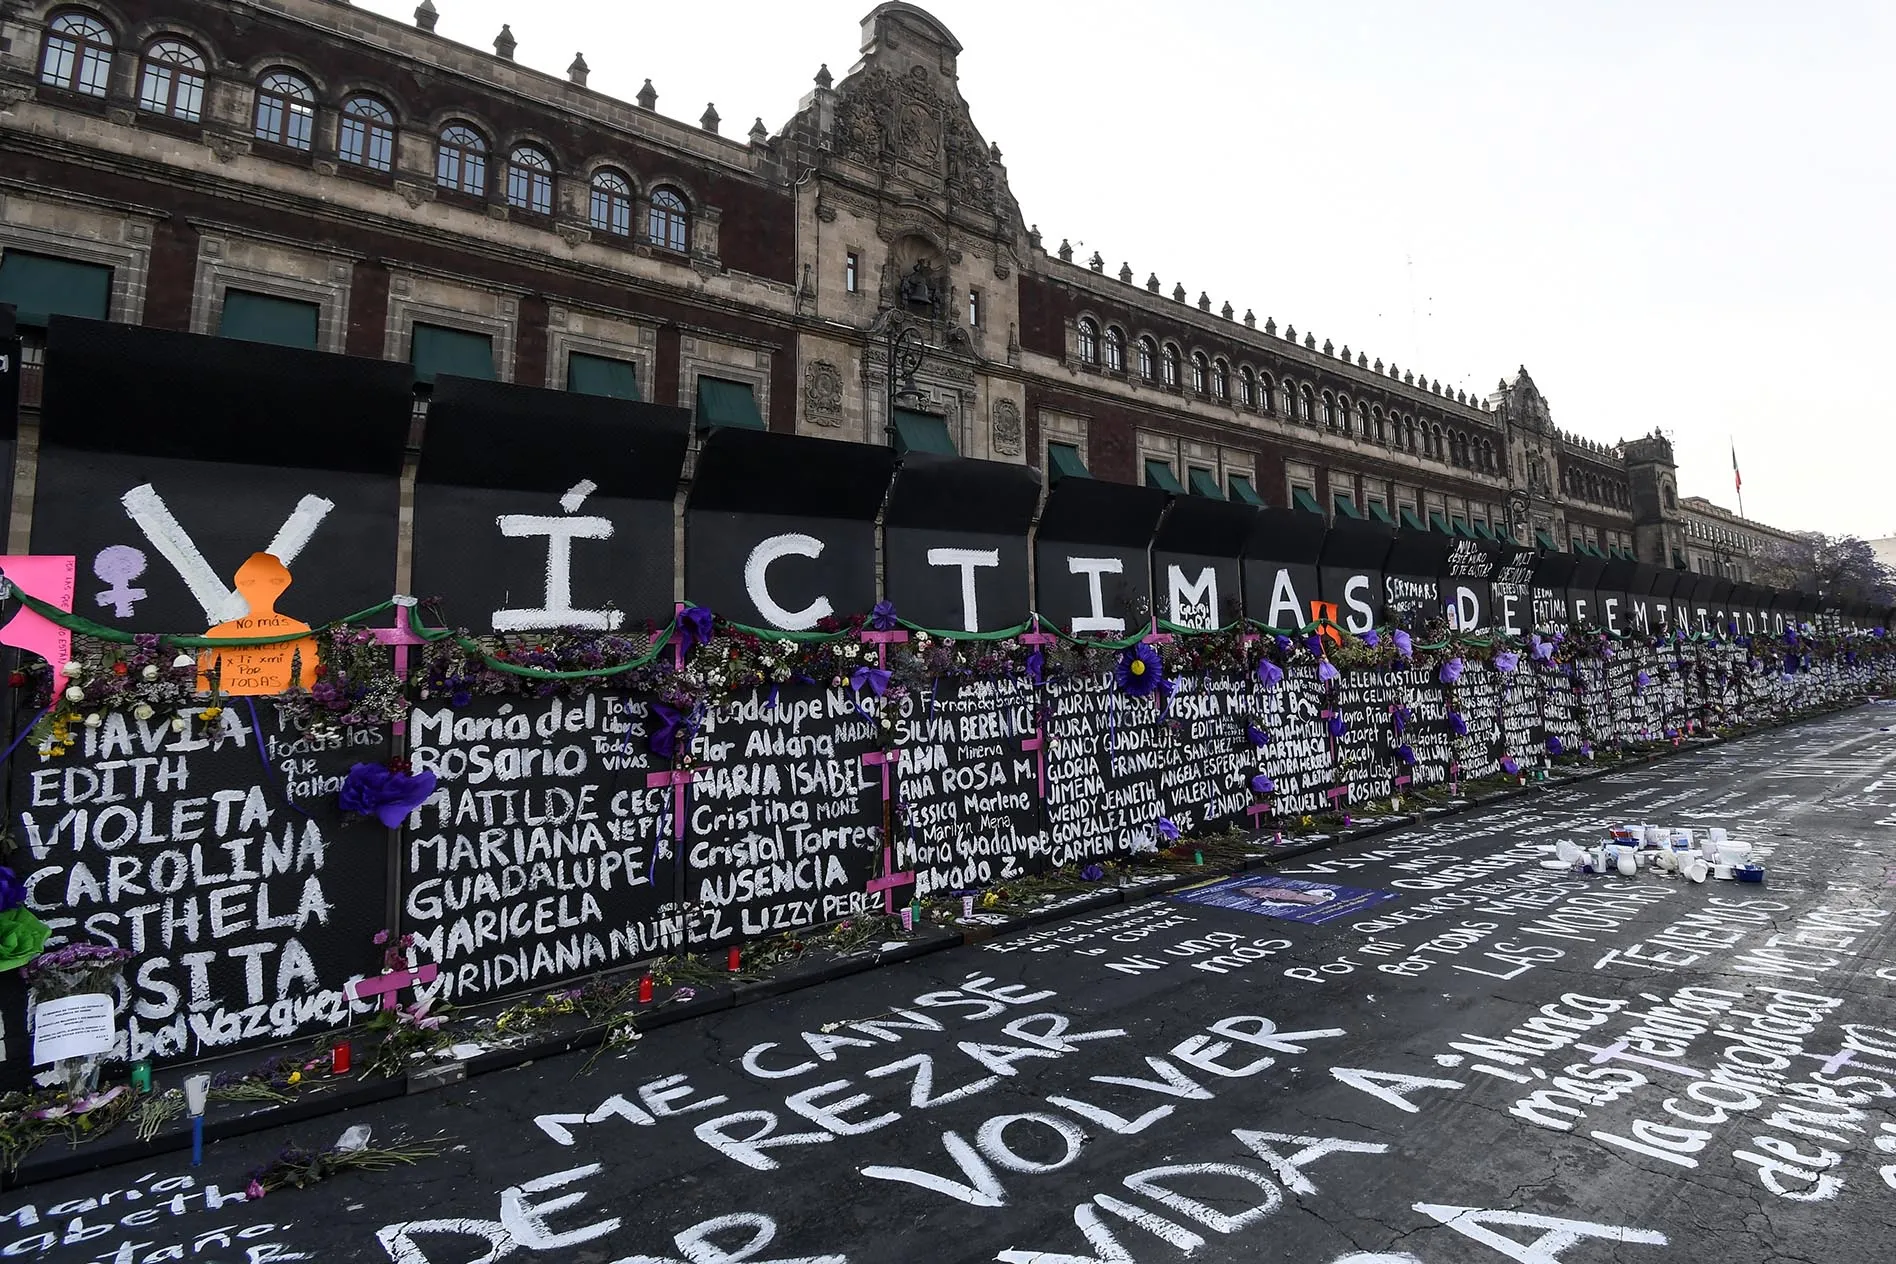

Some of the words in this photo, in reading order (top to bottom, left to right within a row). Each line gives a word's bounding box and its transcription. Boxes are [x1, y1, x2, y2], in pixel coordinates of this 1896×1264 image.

[236, 619, 253, 629] NO
[257, 615, 289, 628] más
[1457, 586, 1521, 636] DE
[1533, 599, 1567, 624] FATIMA
[232, 676, 281, 688] TODAS
[1046, 671, 1119, 698] GRISELD
[1350, 671, 1382, 688] ELENA
[1384, 670, 1430, 687] CASTILLO
[345, 725, 383, 748] las
[410, 702, 531, 748] María
[535, 693, 596, 738] del
[894, 714, 955, 745] SILVIA
[1047, 715, 1093, 738] LAURA
[1191, 717, 1223, 740] EDITH
[690, 734, 735, 762] Flor
[1048, 734, 1099, 763] NANCY
[1257, 738, 1312, 761] MARTHA
[31, 755, 190, 807] EDITH
[280, 758, 318, 781] que
[693, 763, 781, 801] MARIA
[899, 774, 935, 802] ANA
[941, 761, 1007, 794] ROSA
[1047, 757, 1099, 784] GLORIA
[1259, 757, 1299, 778] SANDRA
[1341, 763, 1368, 782] renda
[409, 784, 600, 830] MATILDE
[964, 790, 1031, 816] Marlene
[1049, 775, 1106, 806] JIMENA
[1049, 799, 1098, 824] WENDY
[1101, 779, 1156, 811] JEANETH
[1172, 778, 1221, 807] VALERIA
[1348, 779, 1391, 804] ROSARIO
[21, 785, 275, 860] VIOLETA
[411, 821, 607, 873] MARIANA
[689, 824, 785, 869] Cristal
[1051, 831, 1114, 868] CARMEN
[23, 819, 331, 913] CAROLINA
[406, 846, 650, 920] GUADALUPE
[700, 854, 848, 908] AUSENCIA
[406, 892, 602, 967] MARICELA
[411, 932, 606, 1003] VIRIDIANA
[741, 898, 818, 935] LIZZY
[823, 890, 885, 922] PEREZ
[1104, 953, 1169, 975] Ni
[1190, 937, 1294, 975] más
[1283, 955, 1362, 983] Por
[1452, 941, 1566, 980] LAS
[533, 1073, 729, 1147] ME
[694, 1012, 1126, 1171] REZAR
[861, 1015, 1347, 1207] VOLVER
[1591, 1118, 1713, 1169] la
[1732, 1135, 1847, 1202] de
